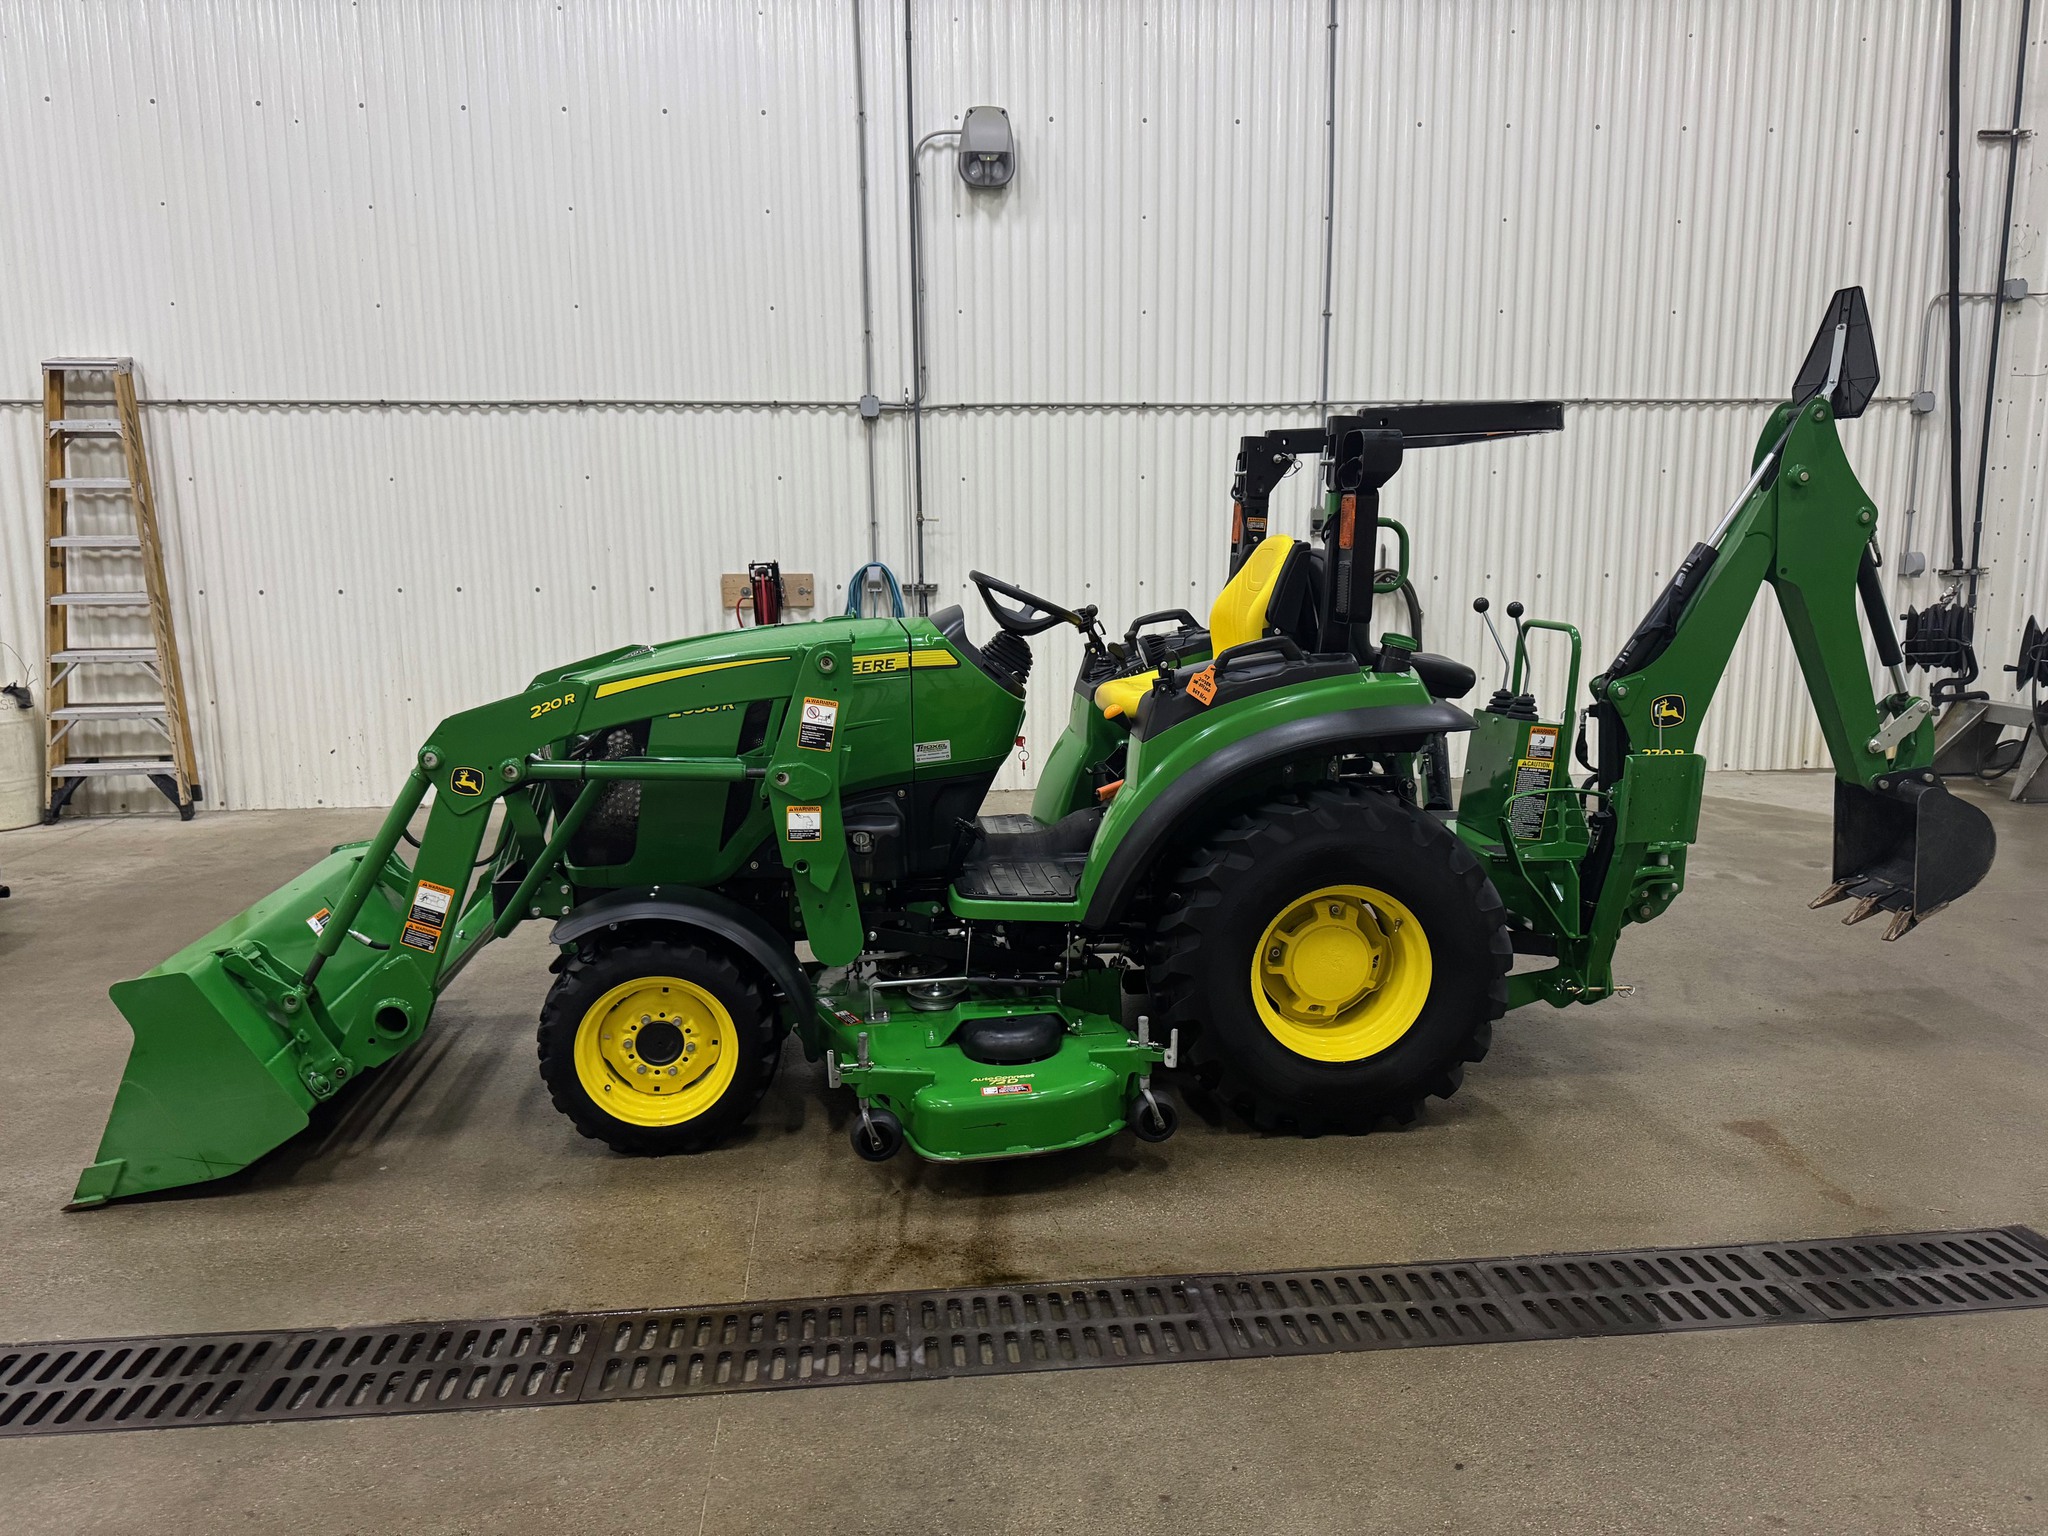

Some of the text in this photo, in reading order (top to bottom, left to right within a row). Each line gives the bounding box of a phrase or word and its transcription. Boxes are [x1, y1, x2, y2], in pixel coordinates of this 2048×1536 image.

[852, 658, 896, 672] EERE
[810, 698, 837, 707] WARNING
[427, 883, 450, 894] WARNING
[414, 924, 437, 935] WARNING
[971, 1073, 1035, 1083] AutoConnect
